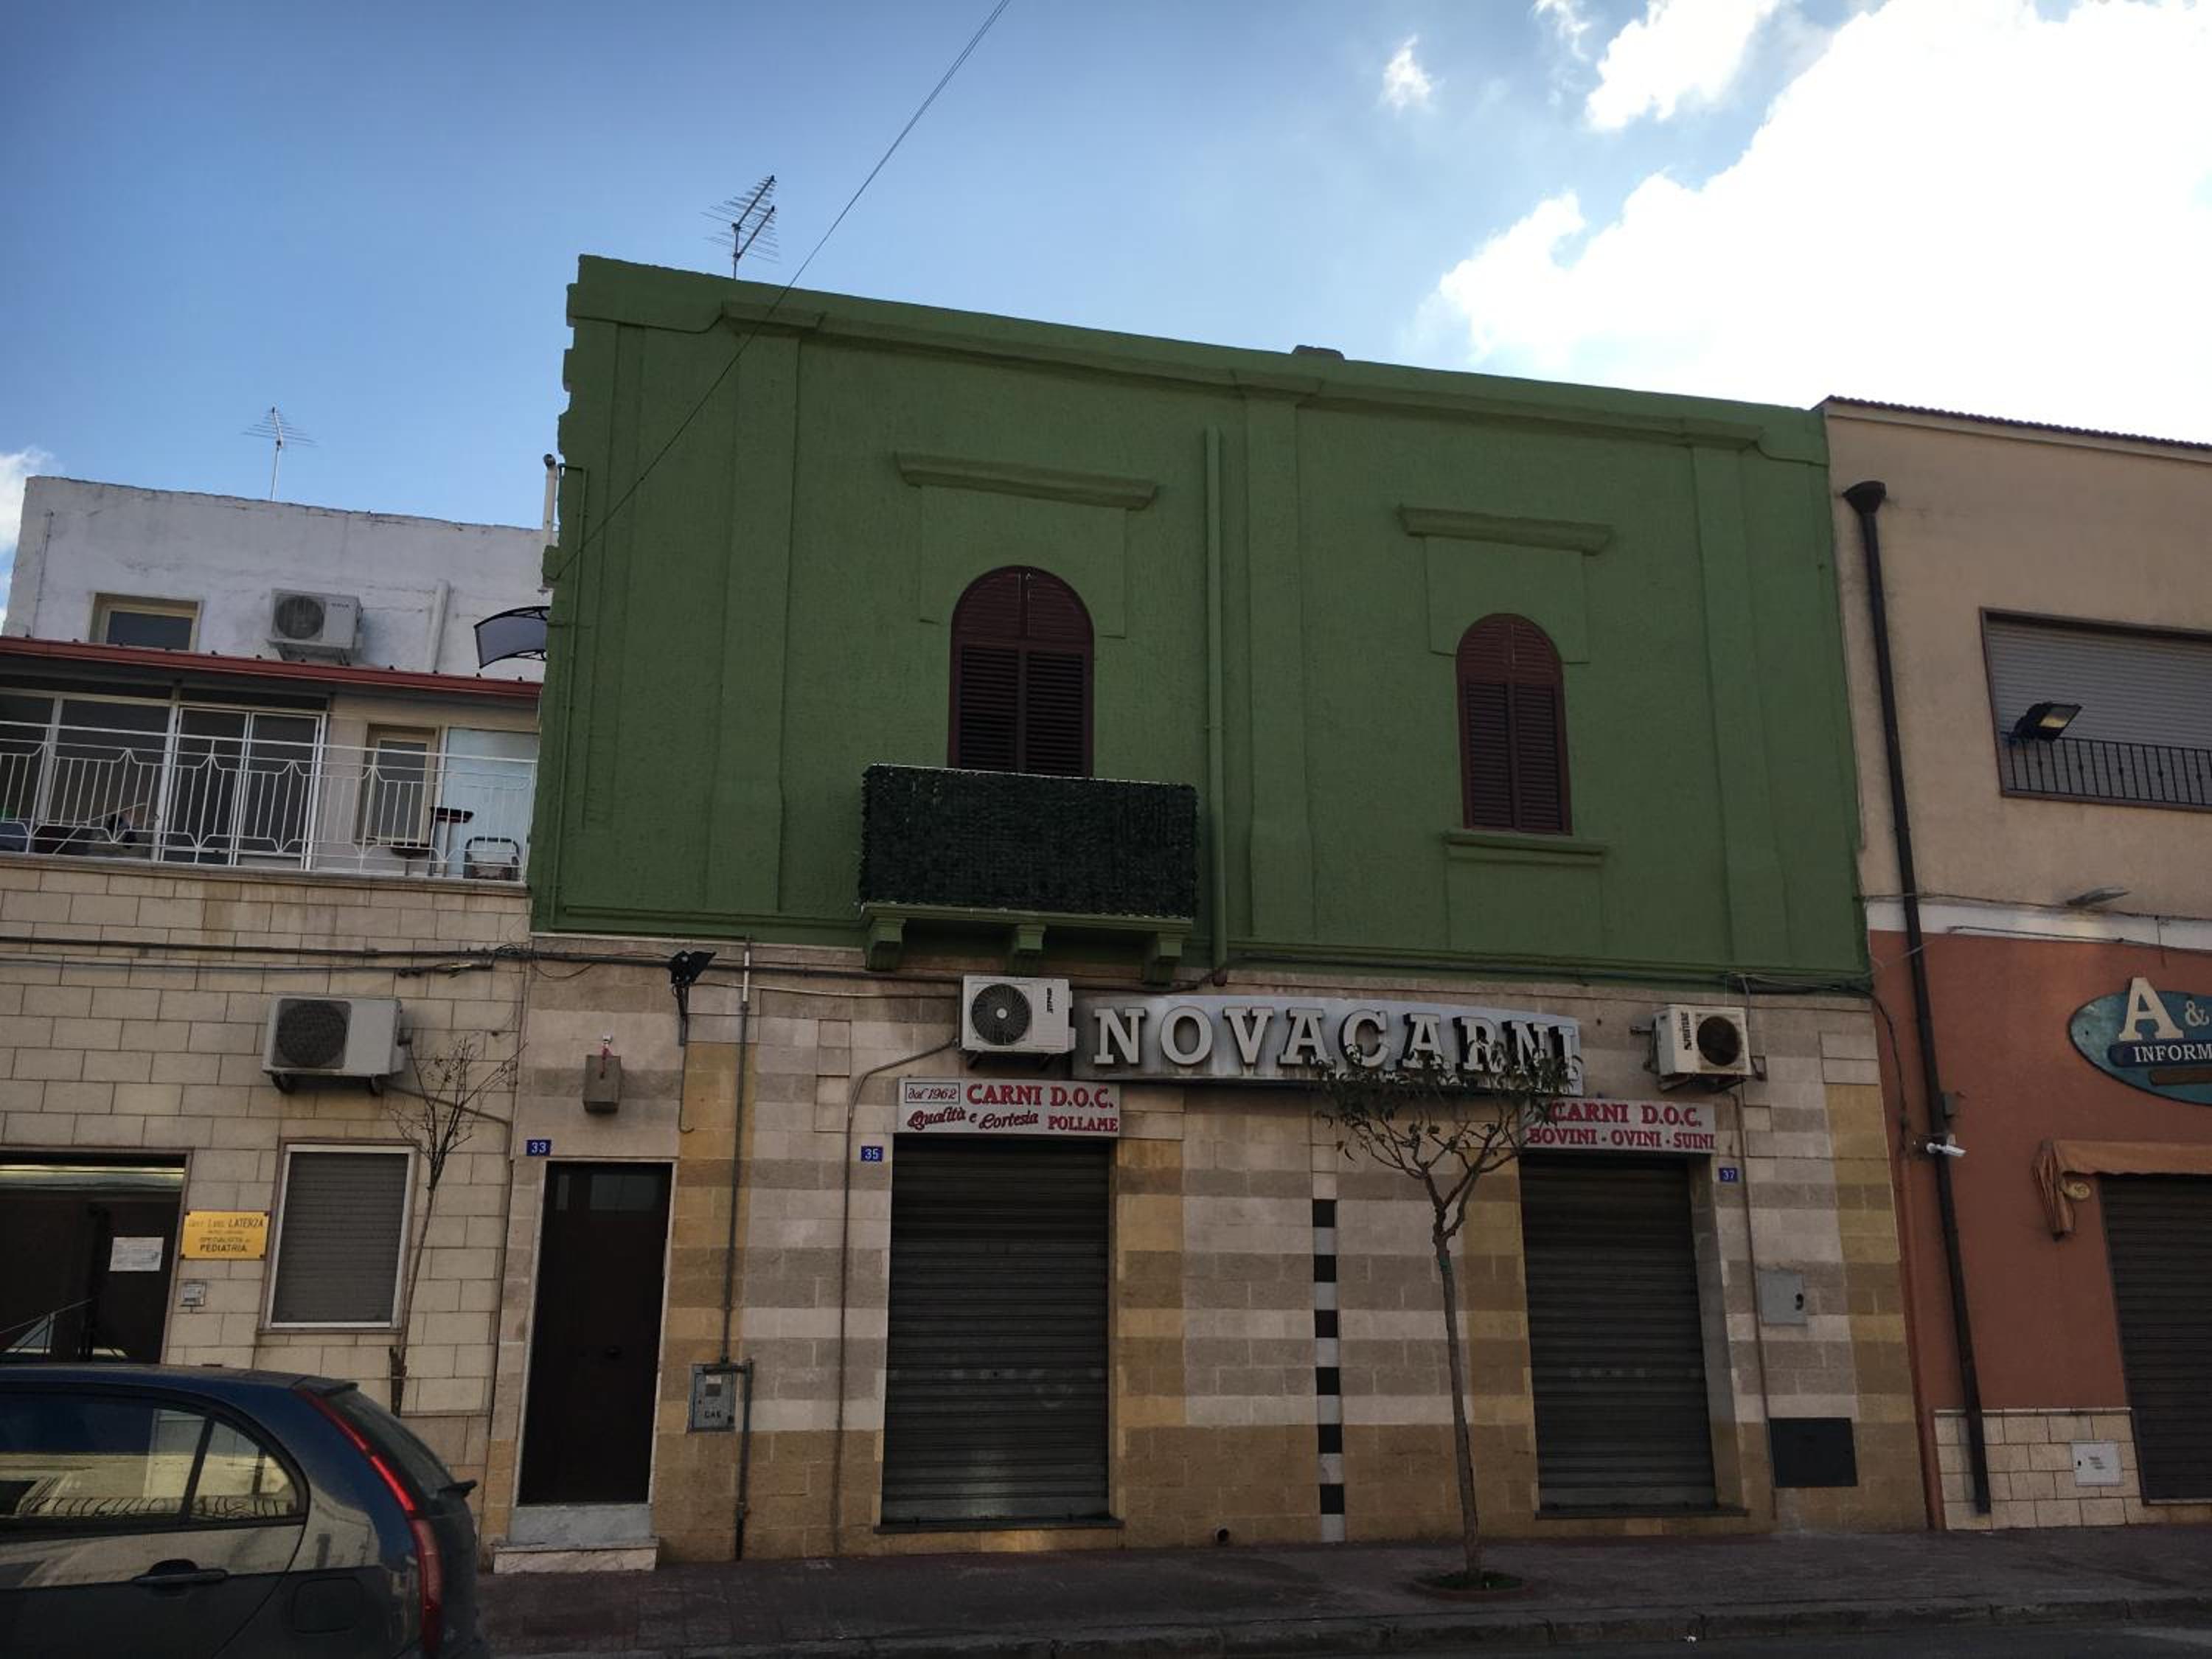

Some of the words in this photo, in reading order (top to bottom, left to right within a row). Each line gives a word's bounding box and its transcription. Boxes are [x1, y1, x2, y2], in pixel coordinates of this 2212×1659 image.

[2118, 977, 2184, 1041] A
[2185, 1000, 2210, 1026] &
[1093, 1006, 1576, 1082] NOVACARNI
[928, 1088, 957, 1100] 1962
[967, 1083, 1043, 1106] CARNI
[1049, 1086, 1114, 1109] D.O.C.
[907, 1106, 967, 1130] Qualità
[969, 1112, 978, 1124] e
[978, 1110, 1040, 1130] Cortesia
[1048, 1115, 1119, 1133] POLLAME
[1550, 1102, 1630, 1123] CARNI
[1641, 1105, 1703, 1127] D.O.C.
[531, 1141, 546, 1154] 33
[1527, 1127, 1598, 1145] BOVINI
[1610, 1130, 1662, 1147] OVINI
[1674, 1132, 1715, 1150] SUINI
[865, 1148, 878, 1160] 35
[1723, 1170, 1735, 1180] 37
[200, 1244, 248, 1252] PEDIATRIA
